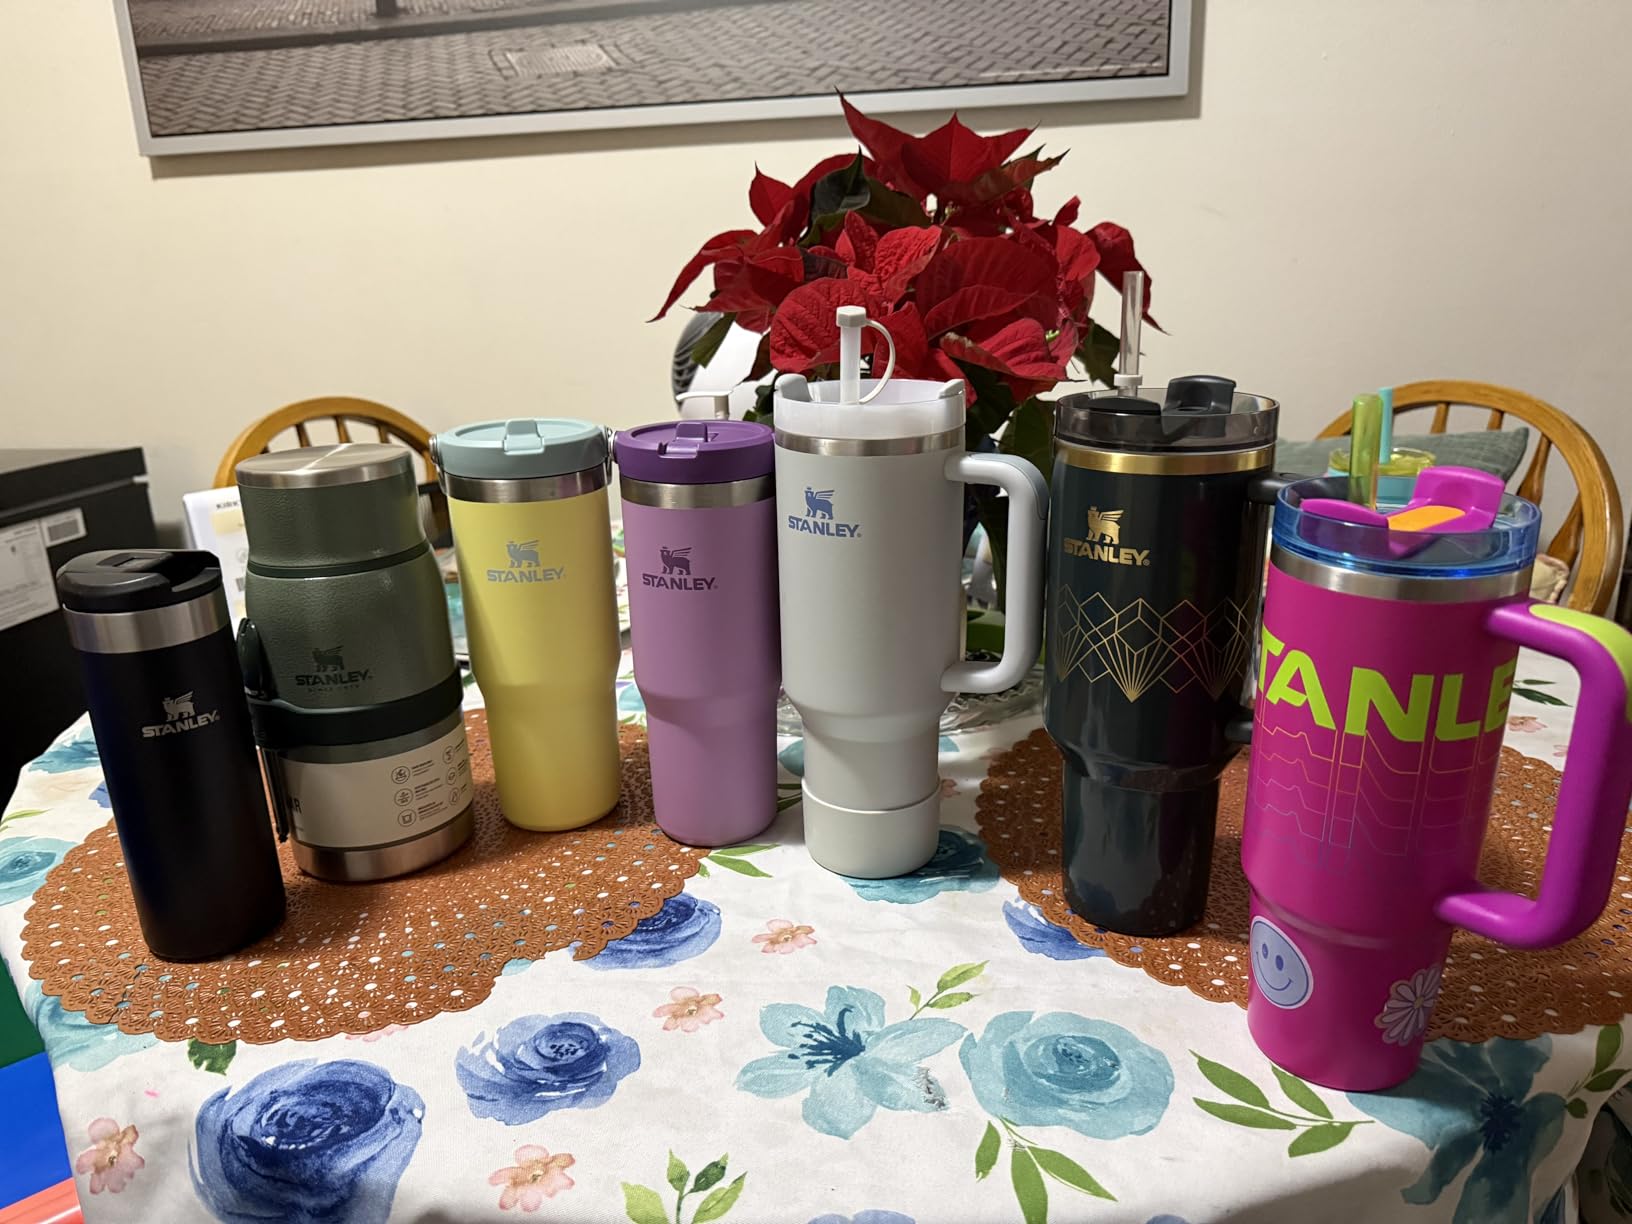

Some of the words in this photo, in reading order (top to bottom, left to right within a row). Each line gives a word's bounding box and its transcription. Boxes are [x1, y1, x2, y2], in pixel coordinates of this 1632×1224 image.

[788, 515, 860, 538] STANLEY
[1063, 537, 1150, 566] STANLEY
[486, 567, 564, 583] STANLEY
[642, 573, 716, 591] STANLEY
[295, 668, 369, 687] STANLEY
[142, 709, 218, 738] STANLEY
